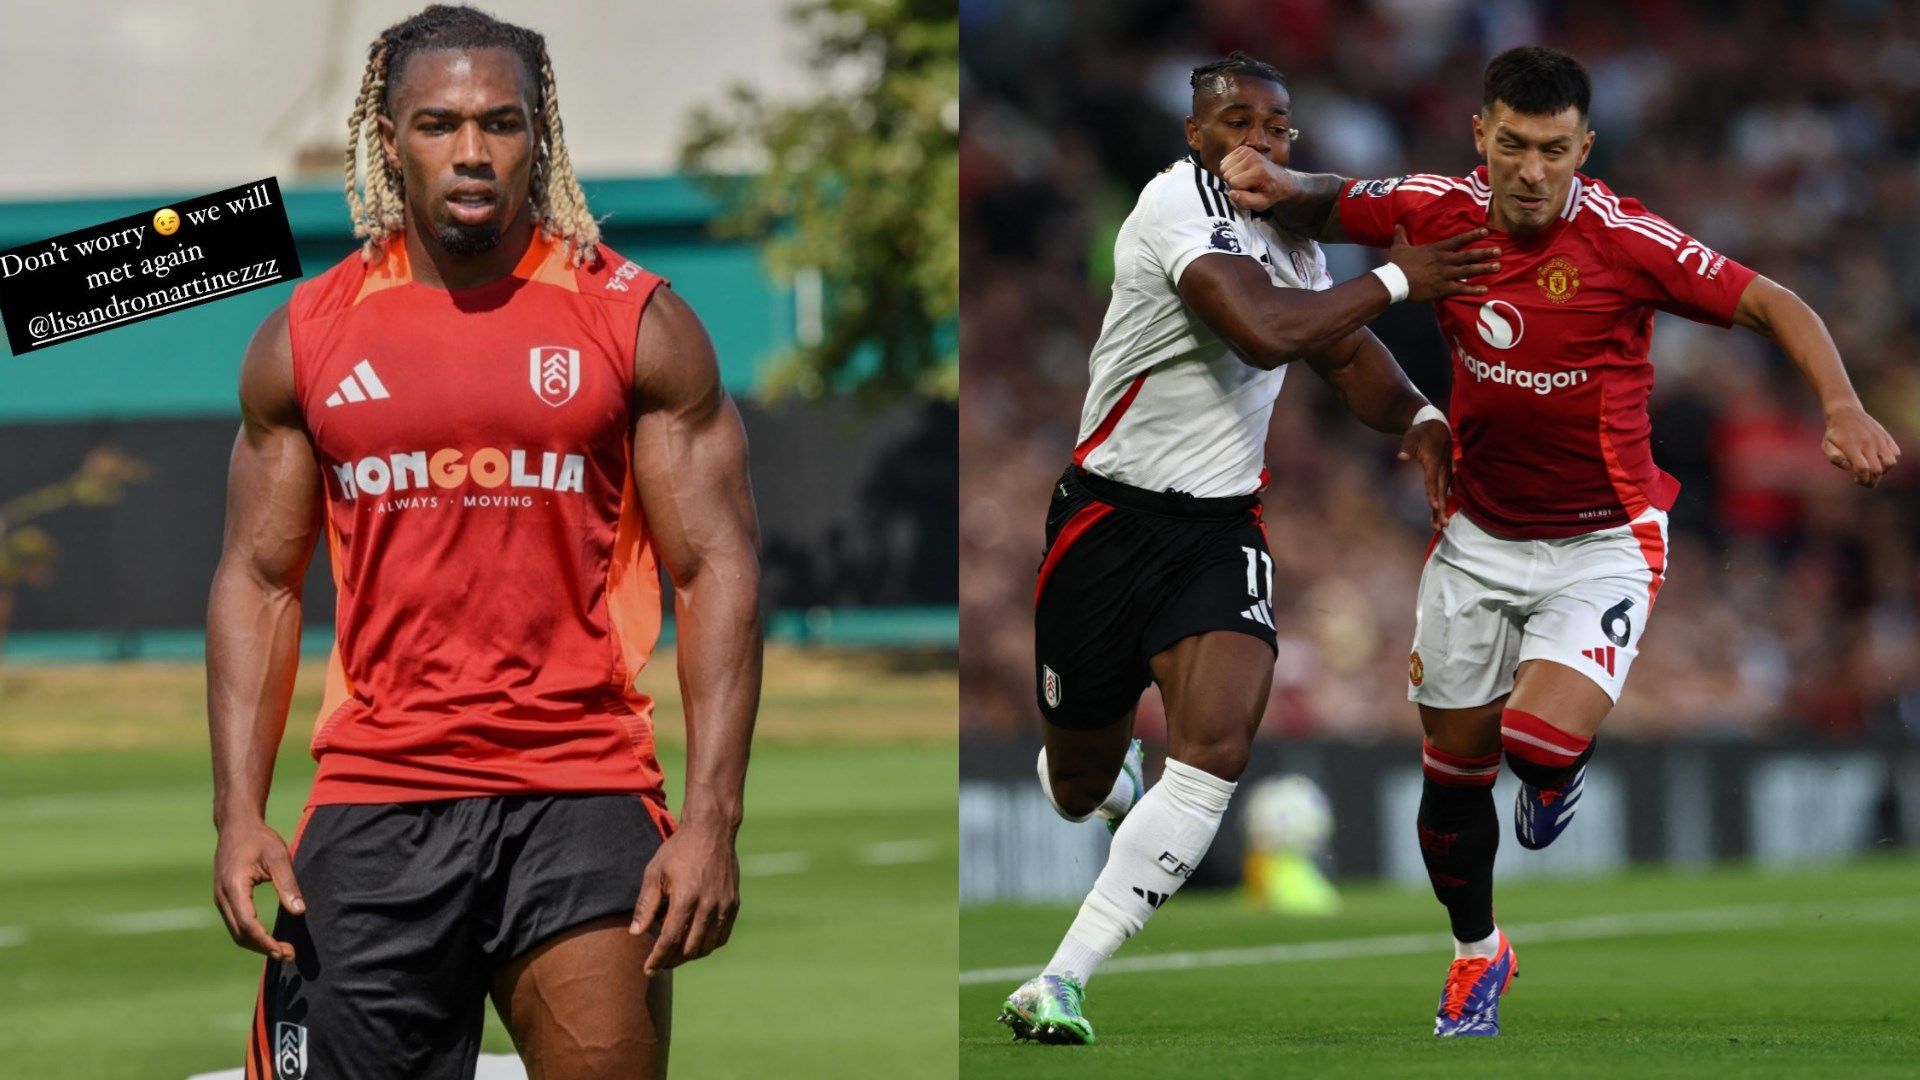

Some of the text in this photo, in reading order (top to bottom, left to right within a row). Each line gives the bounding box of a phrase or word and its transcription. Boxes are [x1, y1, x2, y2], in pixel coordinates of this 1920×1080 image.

[333, 447, 585, 501] MONGOLIA
[377, 496, 439, 514] ALWAYS
[463, 495, 533, 508] MOVING
[1241, 545, 1273, 609] 11
[1600, 597, 1635, 648] 6
